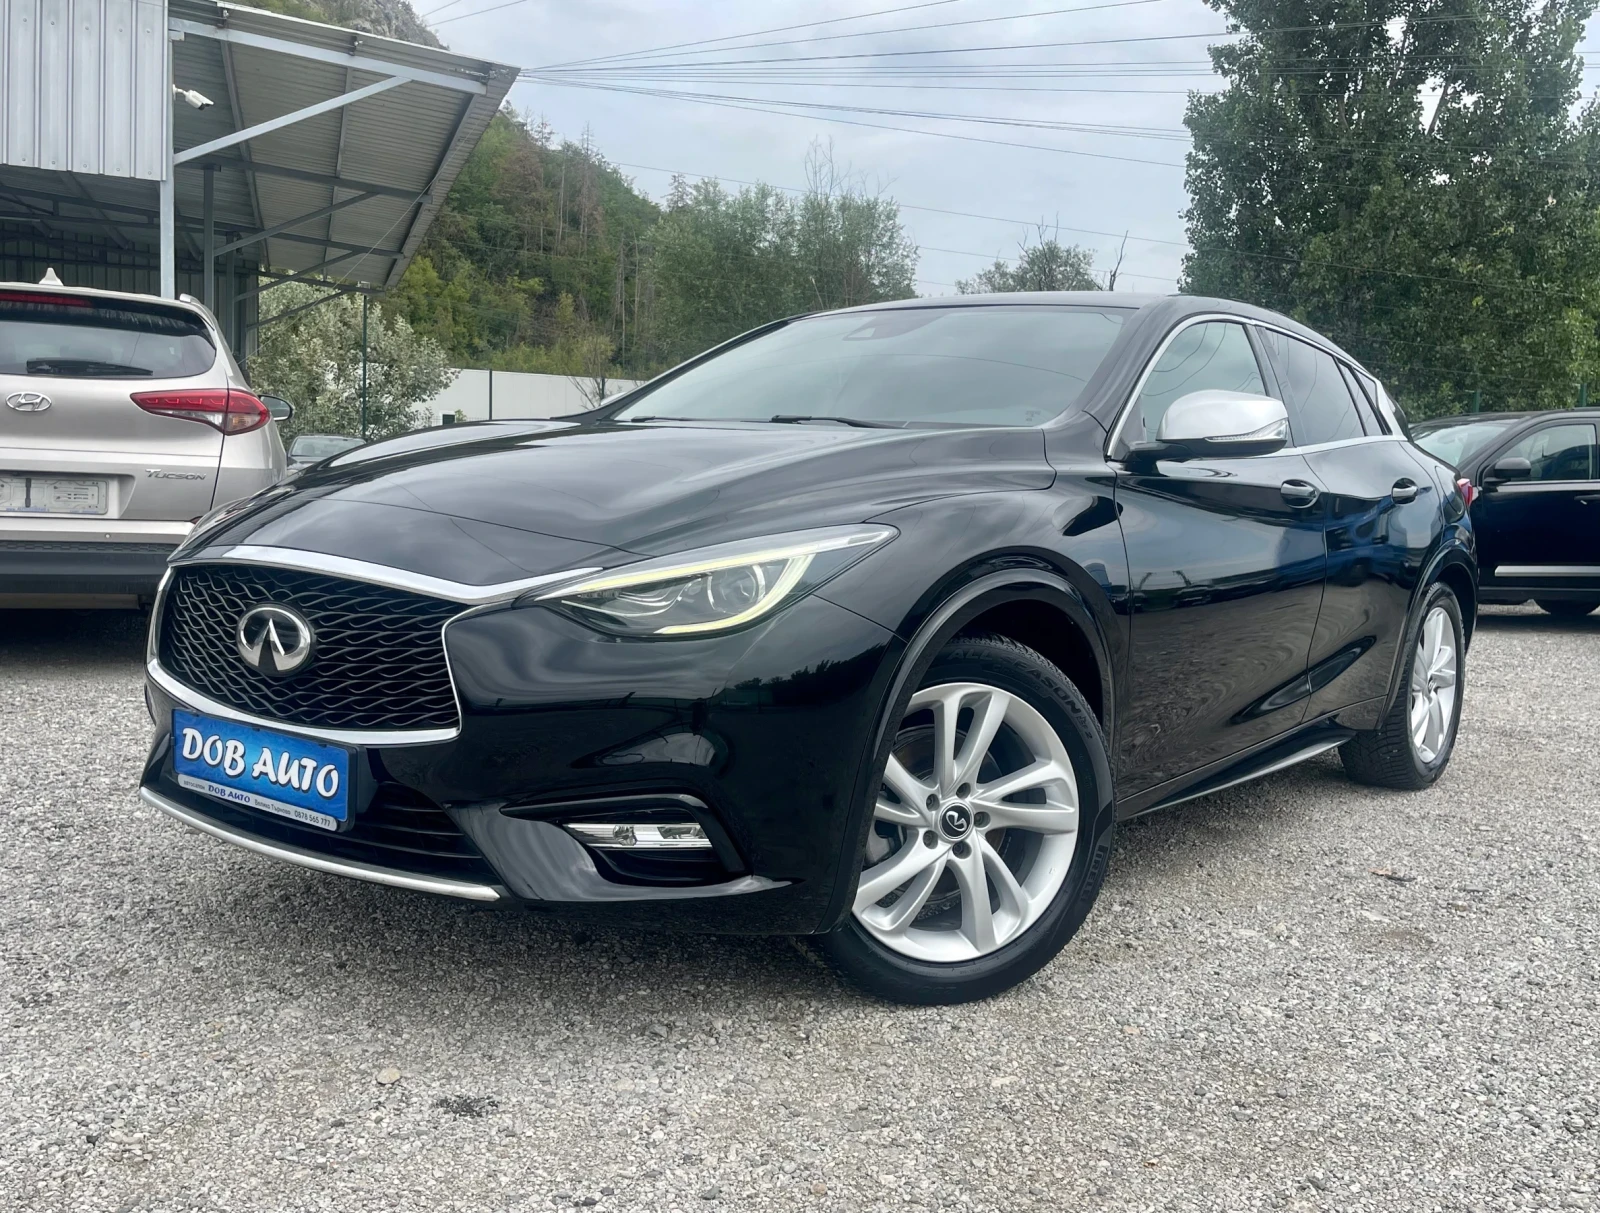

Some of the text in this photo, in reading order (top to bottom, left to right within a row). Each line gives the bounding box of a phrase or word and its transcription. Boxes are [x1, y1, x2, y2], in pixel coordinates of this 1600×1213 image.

[145, 469, 206, 480] TUCSON
[946, 648, 993, 661] ALL
[182, 727, 339, 798] DOB AUTO
[208, 784, 226, 797] DOB
[227, 791, 251, 803] AUTO
[294, 810, 308, 822] 0878
[308, 813, 320, 825] 565
[320, 817, 331, 828] 777
